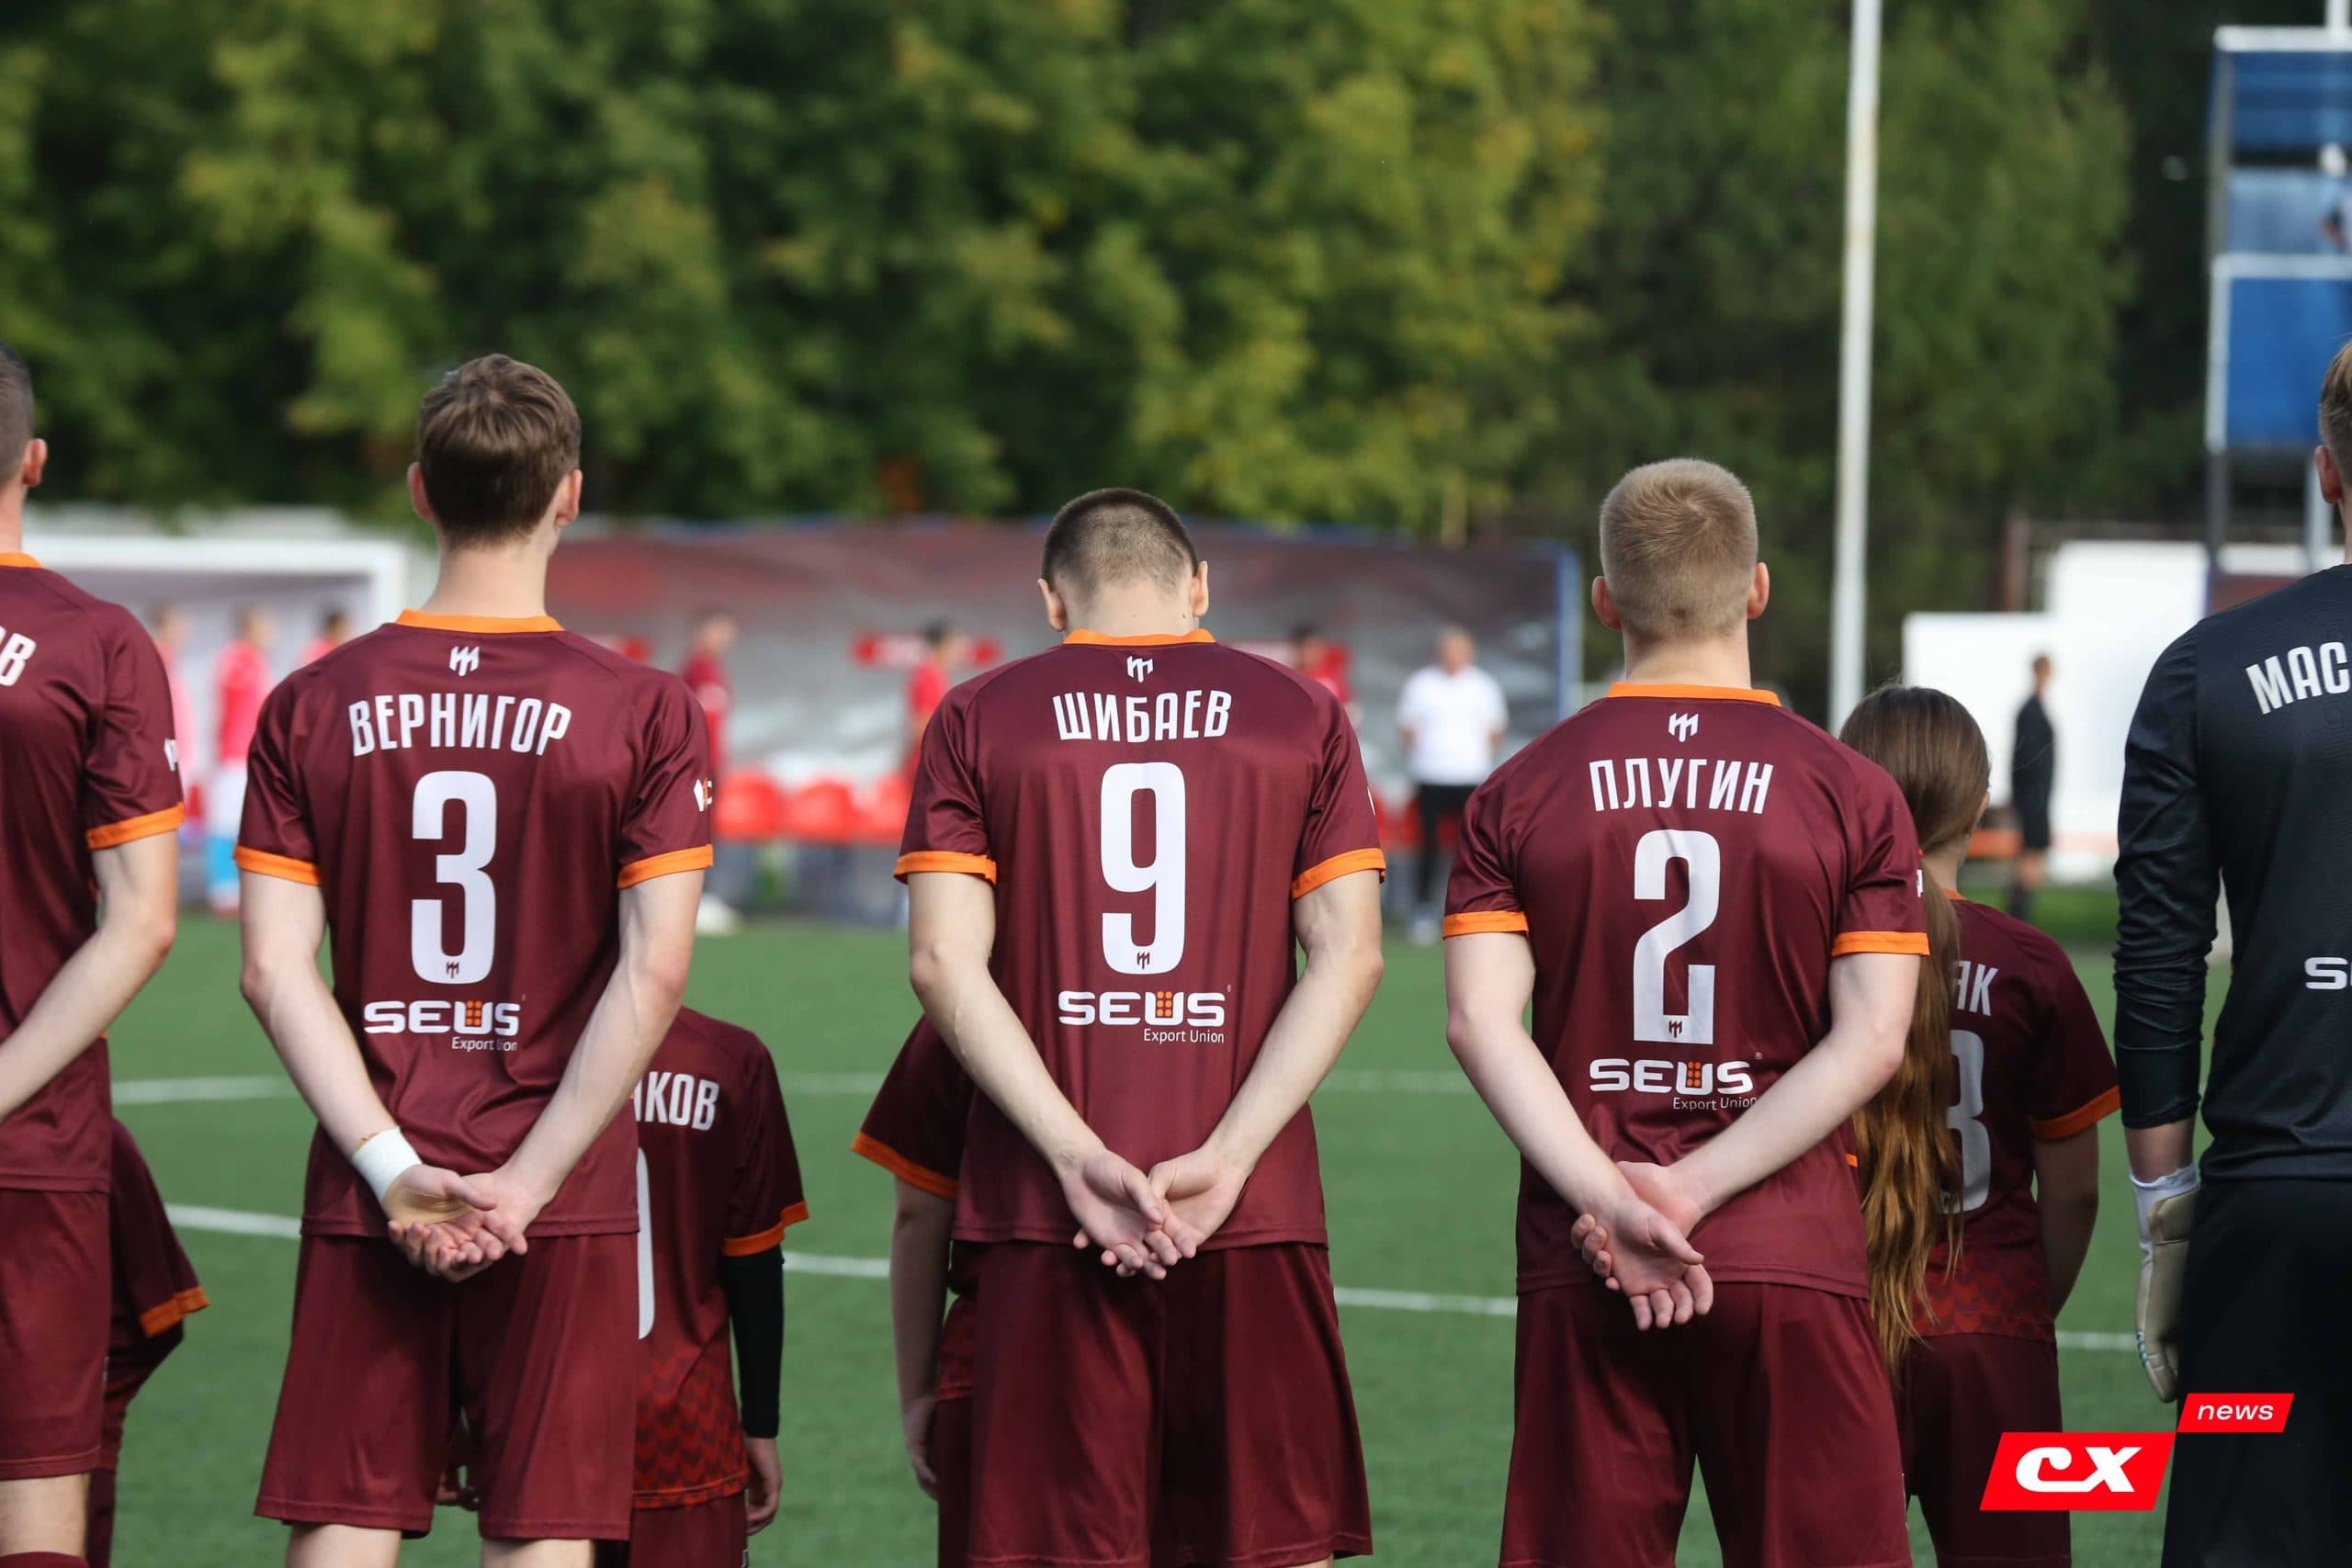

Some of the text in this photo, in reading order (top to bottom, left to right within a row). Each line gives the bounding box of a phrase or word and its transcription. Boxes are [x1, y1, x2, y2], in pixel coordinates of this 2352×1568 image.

[0, 626, 37, 686] В
[348, 693, 572, 757] ВЕРНИГОР
[1052, 689, 1232, 743] ШИБАЕВ
[1589, 757, 1774, 815] ПЛУГИН
[411, 770, 497, 985] 3
[1100, 761, 1186, 975] 9
[1633, 829, 1721, 1045] 2
[2304, 956, 2352, 990] S
[364, 1000, 521, 1036] SEUS
[1057, 990, 1226, 1027] SEUS
[451, 1036, 494, 1053] Export
[1143, 1028, 1225, 1044] Export Union
[1589, 1058, 1754, 1096] SEUS
[1673, 1097, 1717, 1111] Export
